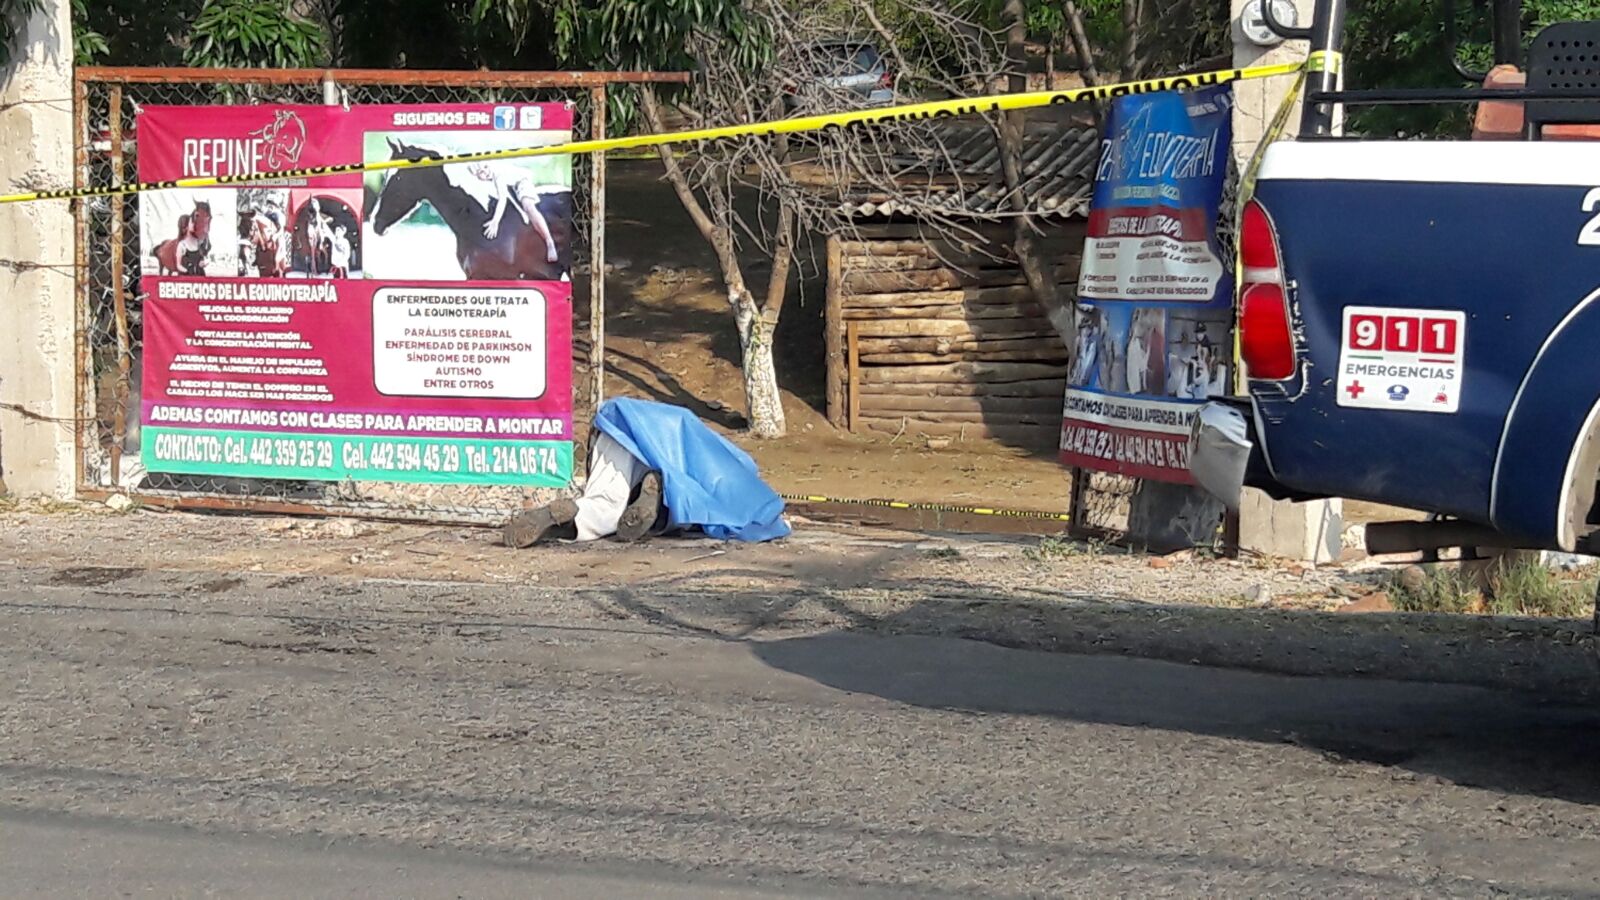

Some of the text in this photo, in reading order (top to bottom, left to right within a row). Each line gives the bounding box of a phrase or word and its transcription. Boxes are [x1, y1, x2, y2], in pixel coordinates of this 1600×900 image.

[393, 112, 464, 125] SIGUENOS
[183, 139, 264, 176] REPINE
[159, 281, 337, 302] BENEFICIOS DE LA EQUINOTERAPÍA
[387, 295, 529, 305] ENFERMEDADES QUE TRATA
[408, 307, 507, 318] LA EQUINOTERAPÍA
[404, 326, 512, 338] PARÁLISIS CEREBRAL
[276, 341, 312, 349] MENTAL
[385, 341, 532, 351] ENFERMEDAD DE PARKINSON
[407, 352, 510, 363] SÍNDROME DE DOWN
[436, 367, 482, 376] AUTISMO
[1345, 364, 1454, 379] EMERGENCIAS
[424, 379, 494, 389] ENTRE OTROS
[151, 406, 563, 435] ADEMAS CONTAMOS CON CLASES PARA APRENDER A MONTAR
[155, 434, 557, 474] CONTACTO: Cel. 442 359 25 29 Cel. 442 594 45 29 Tel. 214 06 74
